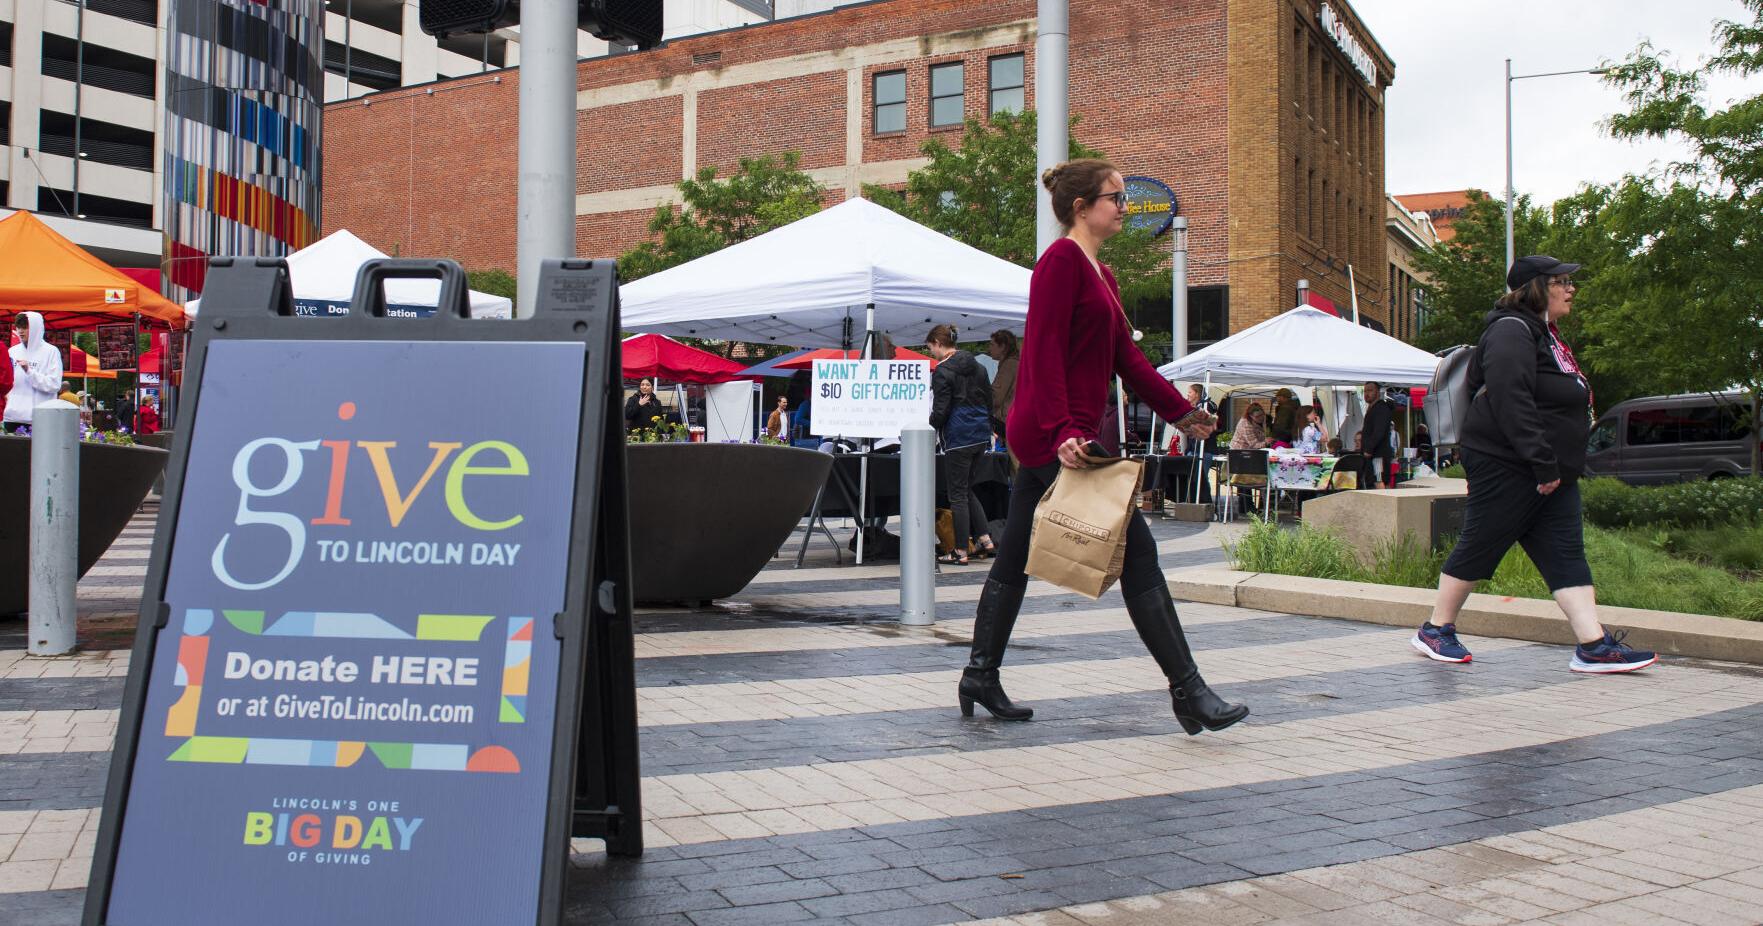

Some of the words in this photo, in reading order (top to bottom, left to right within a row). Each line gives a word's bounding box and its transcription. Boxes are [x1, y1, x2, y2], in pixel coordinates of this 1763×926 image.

[1143, 200, 1171, 213] House
[387, 309, 417, 318] tation
[817, 363, 858, 380] WANT
[869, 363, 878, 380] A
[888, 364, 922, 380] FREE
[820, 382, 842, 399] $10
[851, 382, 926, 400] GIFTCARD?
[211, 401, 530, 590] give
[1063, 517, 1109, 540] CHIPOTLE
[316, 540, 349, 562] TO
[355, 540, 464, 565] LINCOLN
[470, 543, 521, 565] DAY
[224, 651, 359, 682] Donate
[370, 655, 480, 686] HERE
[217, 697, 242, 715] or
[246, 696, 269, 717] at
[274, 694, 474, 723] GiveToLincoln.com
[273, 798, 358, 811] LINCOLN'S
[367, 800, 400, 812] ONE
[243, 812, 322, 848] BIG
[332, 815, 425, 851] DAY
[287, 851, 308, 863] OF
[315, 853, 371, 865] GIVING
